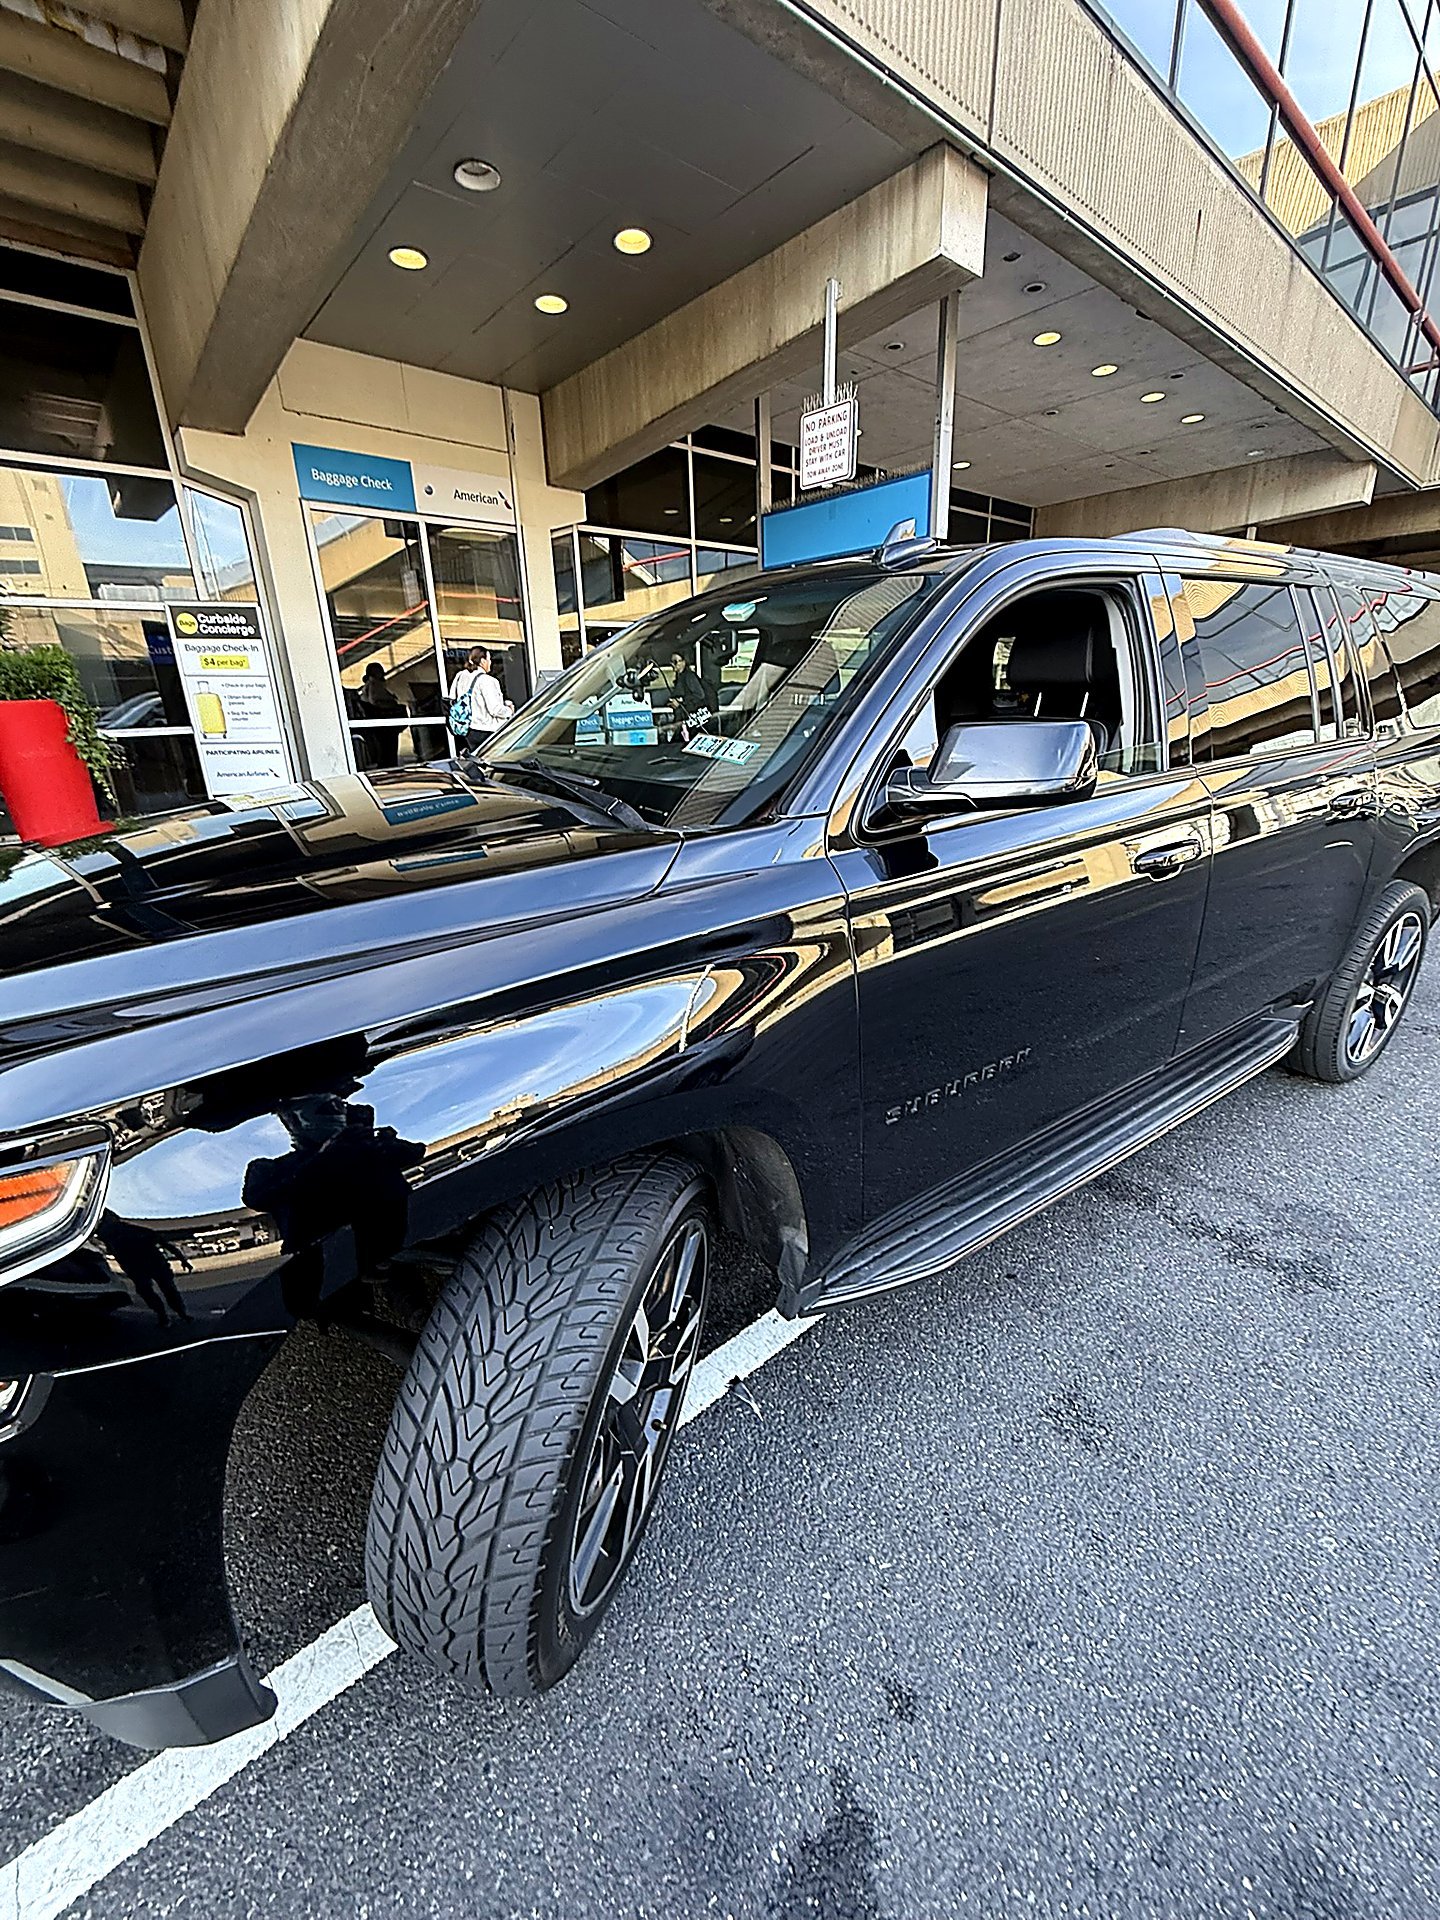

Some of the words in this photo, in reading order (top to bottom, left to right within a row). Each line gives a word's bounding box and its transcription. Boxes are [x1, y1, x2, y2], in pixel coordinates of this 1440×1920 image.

[805, 421, 816, 433] NO
[818, 410, 848, 429] PARKING
[804, 435, 818, 447] LOAD
[820, 433, 824, 442] &
[826, 426, 848, 441] UNLOAD
[808, 443, 827, 456] DRIVER
[828, 438, 843, 450] MUST
[805, 457, 817, 468] STAY
[819, 452, 833, 464] WITH
[834, 448, 846, 459] CAR
[311, 468, 359, 488] Baggage
[360, 475, 393, 491] Check
[453, 489, 499, 505] American
[197, 611, 247, 625] Curbside
[199, 623, 255, 637] Concierge
[184, 643, 221, 653] Baggage
[222, 643, 259, 652] Check-In
[203, 657, 215, 666] $4
[216, 659, 228, 667] per
[884, 1047, 1032, 1126] SUBURBAN
